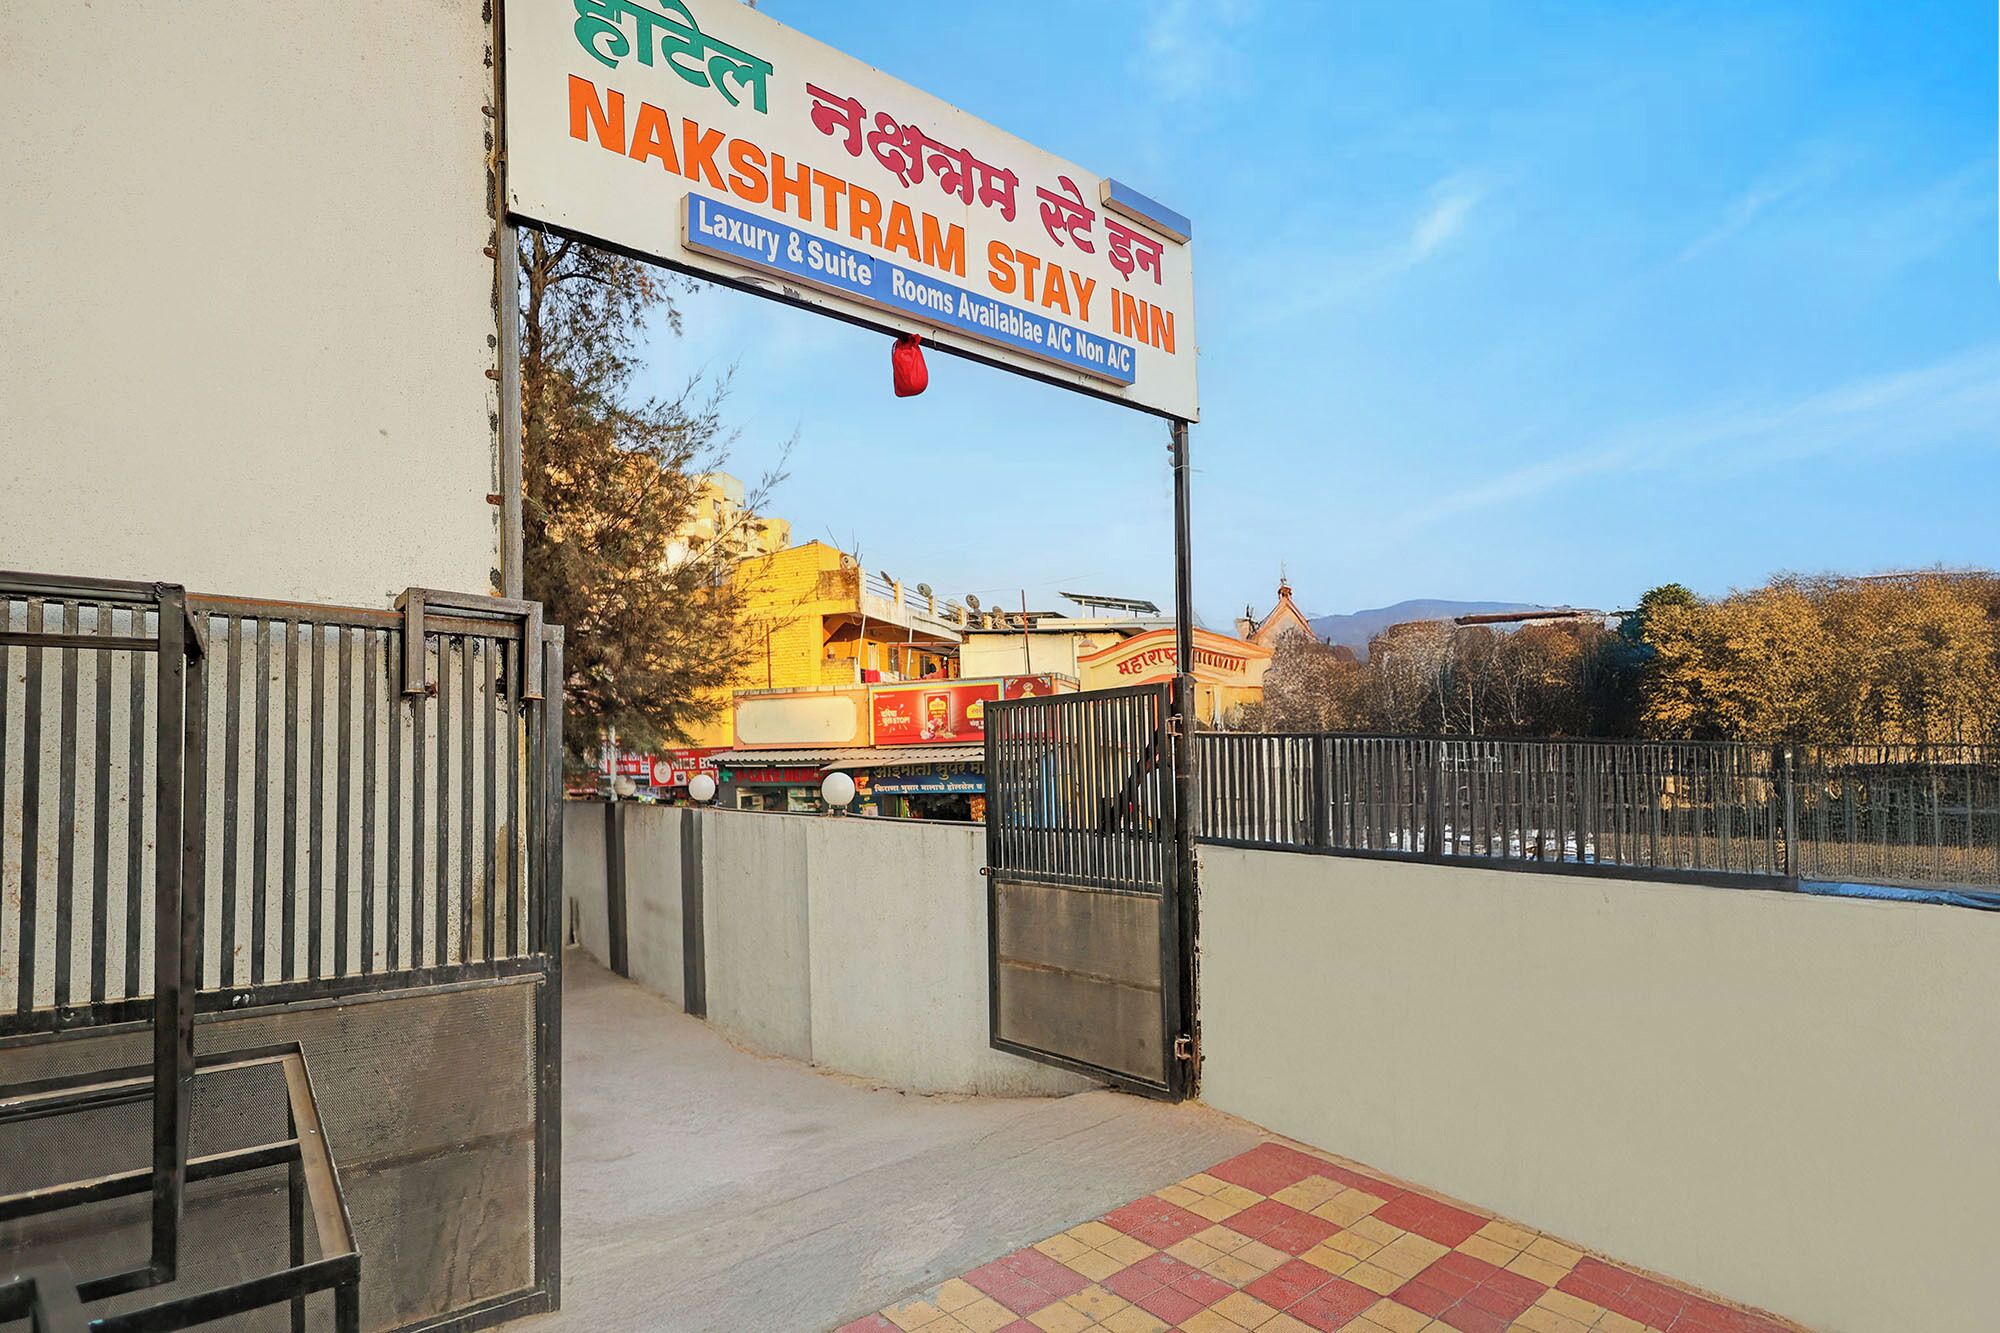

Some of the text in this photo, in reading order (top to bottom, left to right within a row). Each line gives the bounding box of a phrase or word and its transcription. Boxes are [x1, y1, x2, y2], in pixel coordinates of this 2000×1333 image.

[568, 73, 1176, 355] NAKSHTRAM STAY INN
[699, 199, 780, 262] Laxury
[807, 240, 873, 286] Suite
[891, 267, 954, 314] Rooms
[958, 292, 1043, 344] Availablae
[1046, 322, 1072, 353] A/C
[1076, 331, 1104, 362] Non
[1107, 342, 1131, 372] A/C
[1036, 175, 1096, 254] स्टे
[1104, 217, 1164, 286] इन
